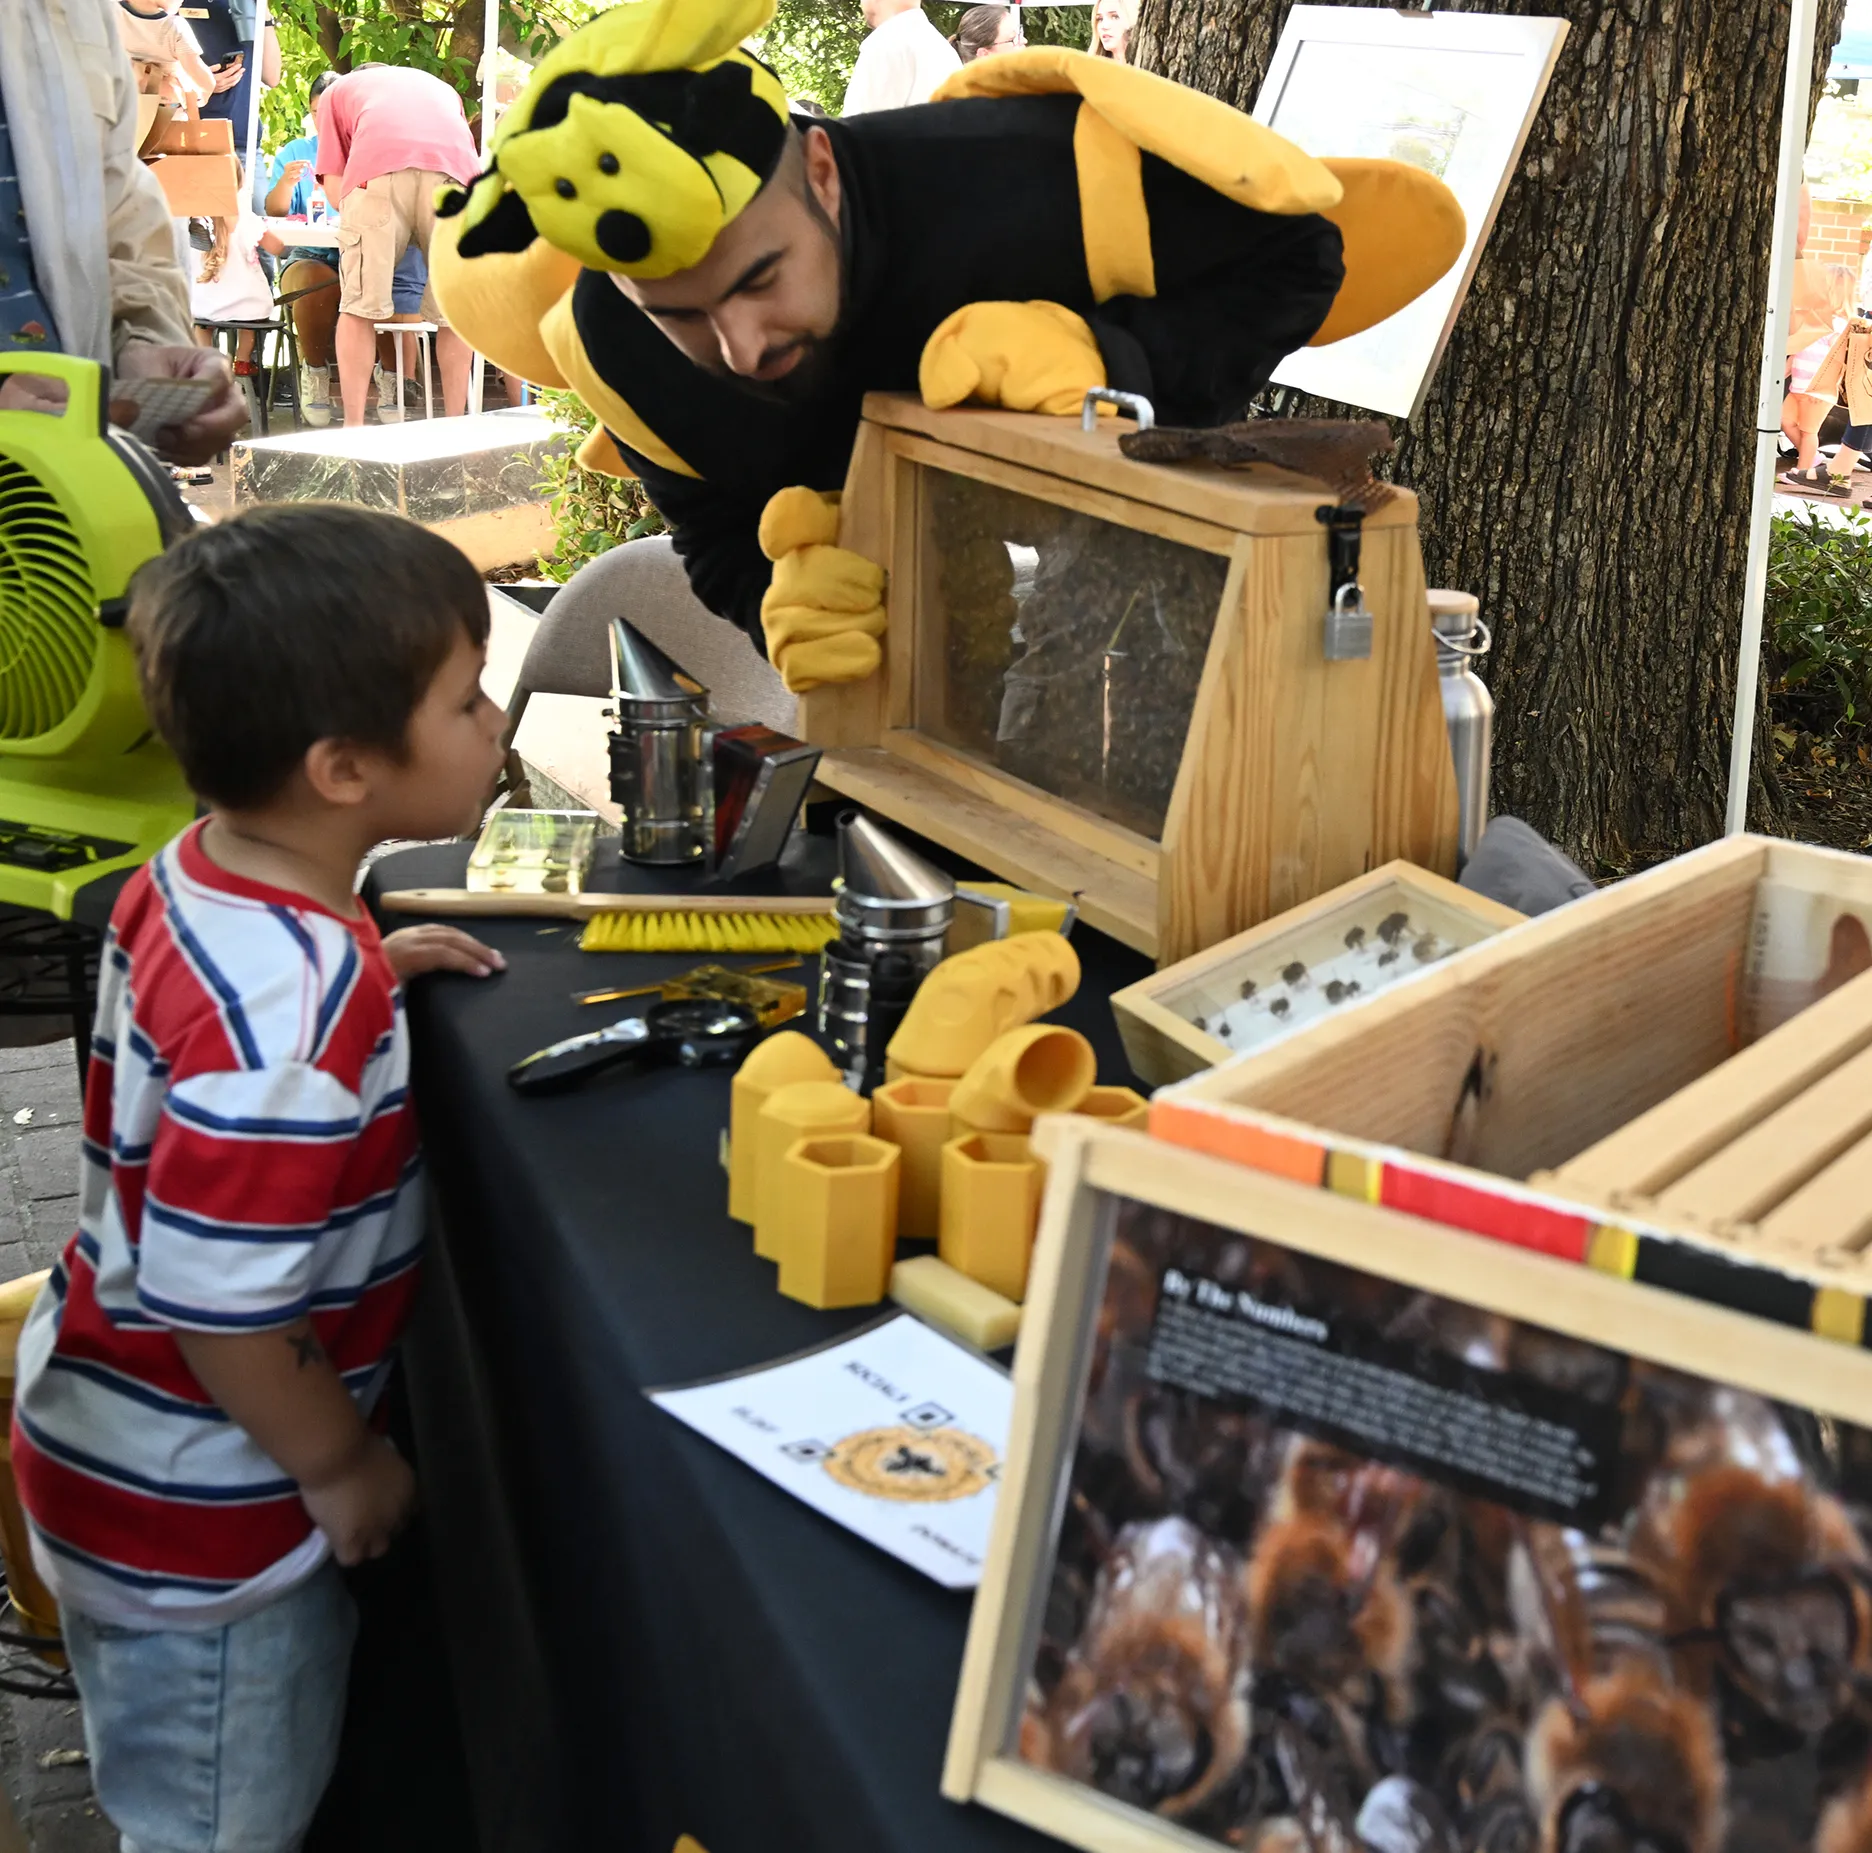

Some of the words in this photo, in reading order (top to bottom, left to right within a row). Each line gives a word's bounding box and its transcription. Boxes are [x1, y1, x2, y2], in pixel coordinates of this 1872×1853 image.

[1163, 1267, 1191, 1301] By
[1196, 1277, 1235, 1312] The
[1237, 1290, 1329, 1342] Numbers
